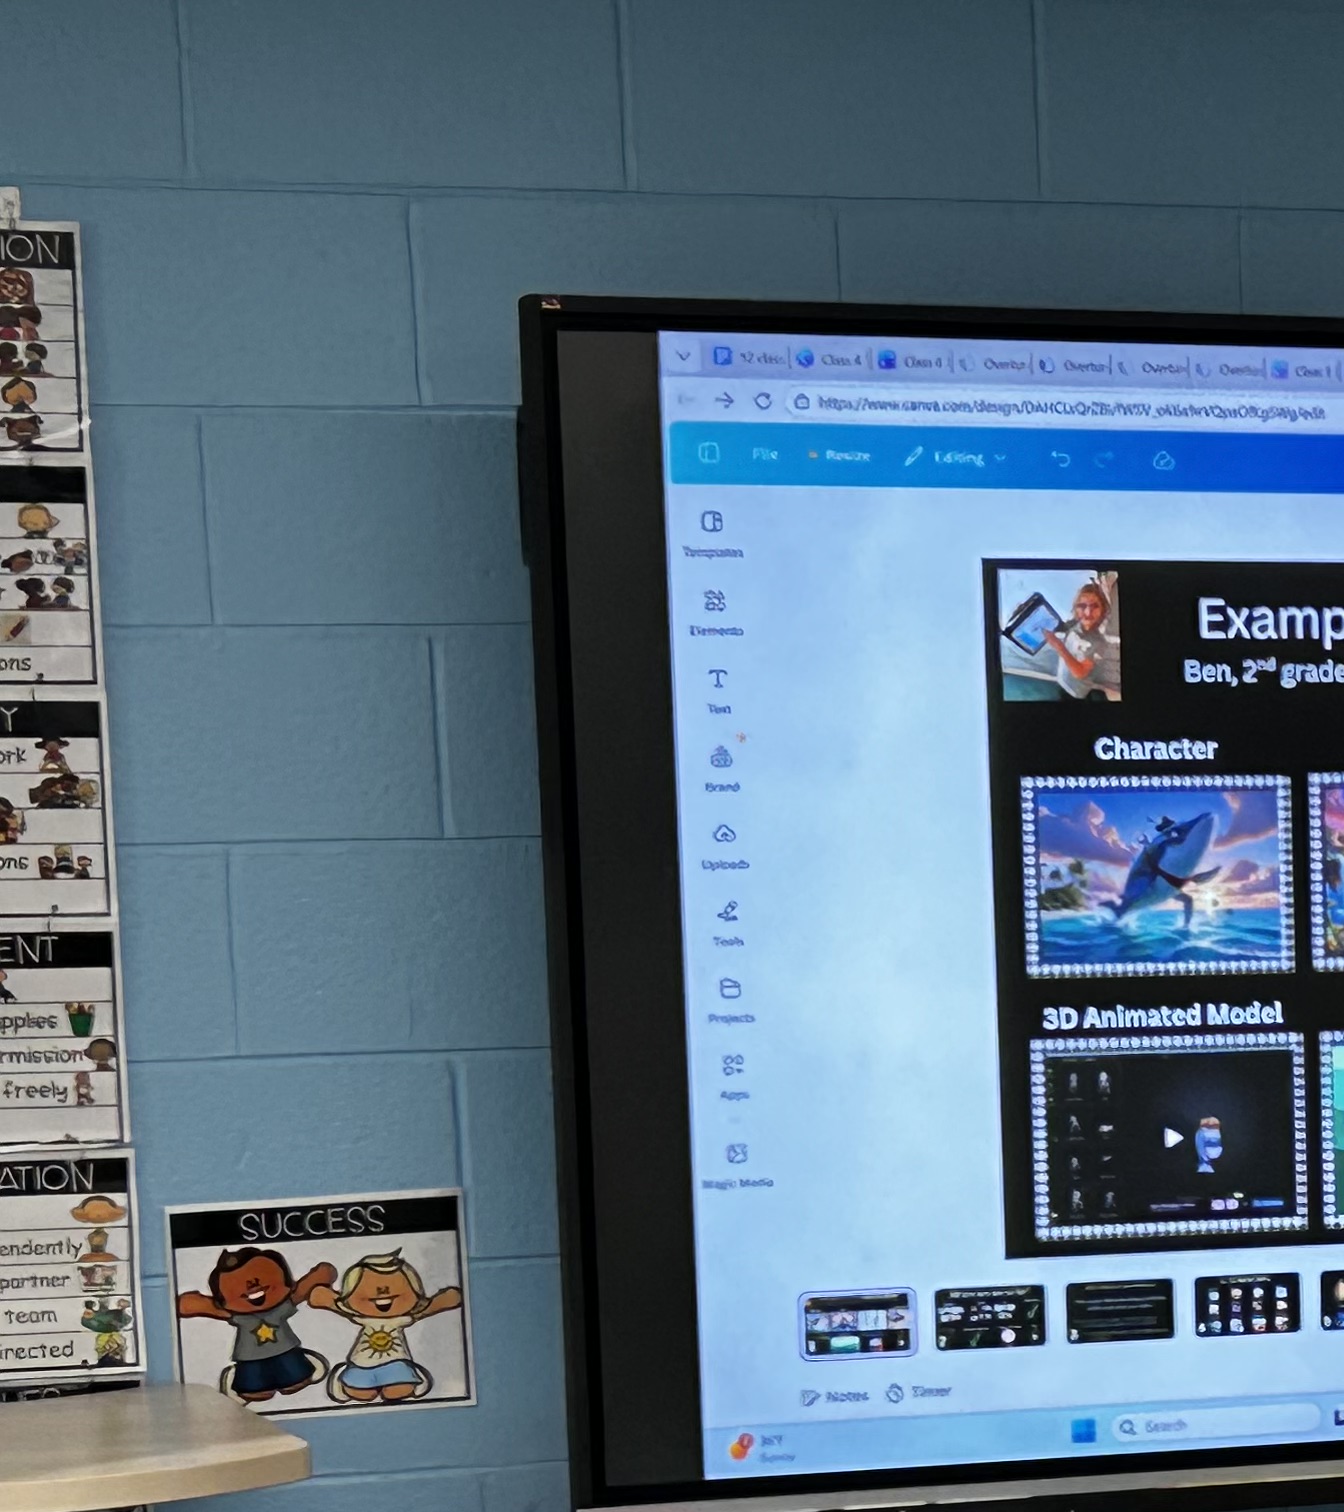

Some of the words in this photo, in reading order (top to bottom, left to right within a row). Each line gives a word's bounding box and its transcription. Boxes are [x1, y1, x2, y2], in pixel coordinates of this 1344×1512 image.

[1183, 658, 1239, 687] Ben,
[1242, 656, 1277, 684] 2nd
[1094, 736, 1219, 761] Character
[1042, 1006, 1079, 1031] 3D
[1083, 1003, 1201, 1030] Animated
[1206, 1000, 1285, 1027] Model
[3, 1080, 68, 1104] freely
[238, 1205, 387, 1241] SUCCESS
[4, 1309, 58, 1325] team
